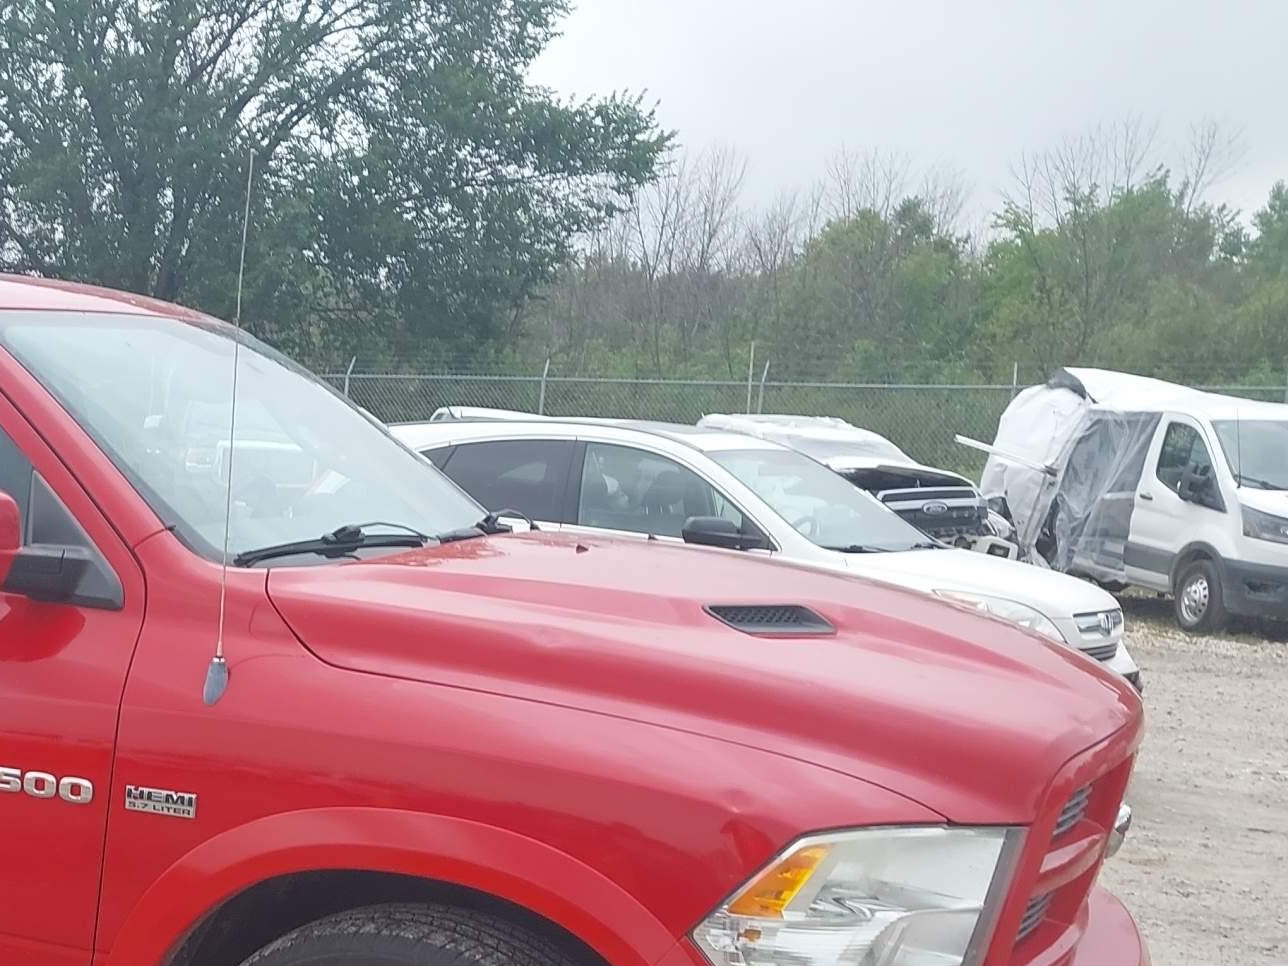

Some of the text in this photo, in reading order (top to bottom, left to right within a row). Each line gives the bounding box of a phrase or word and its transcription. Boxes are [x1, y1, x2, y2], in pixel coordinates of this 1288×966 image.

[126, 787, 194, 807] HEMI
[128, 801, 191, 816] 5.7 LITER
